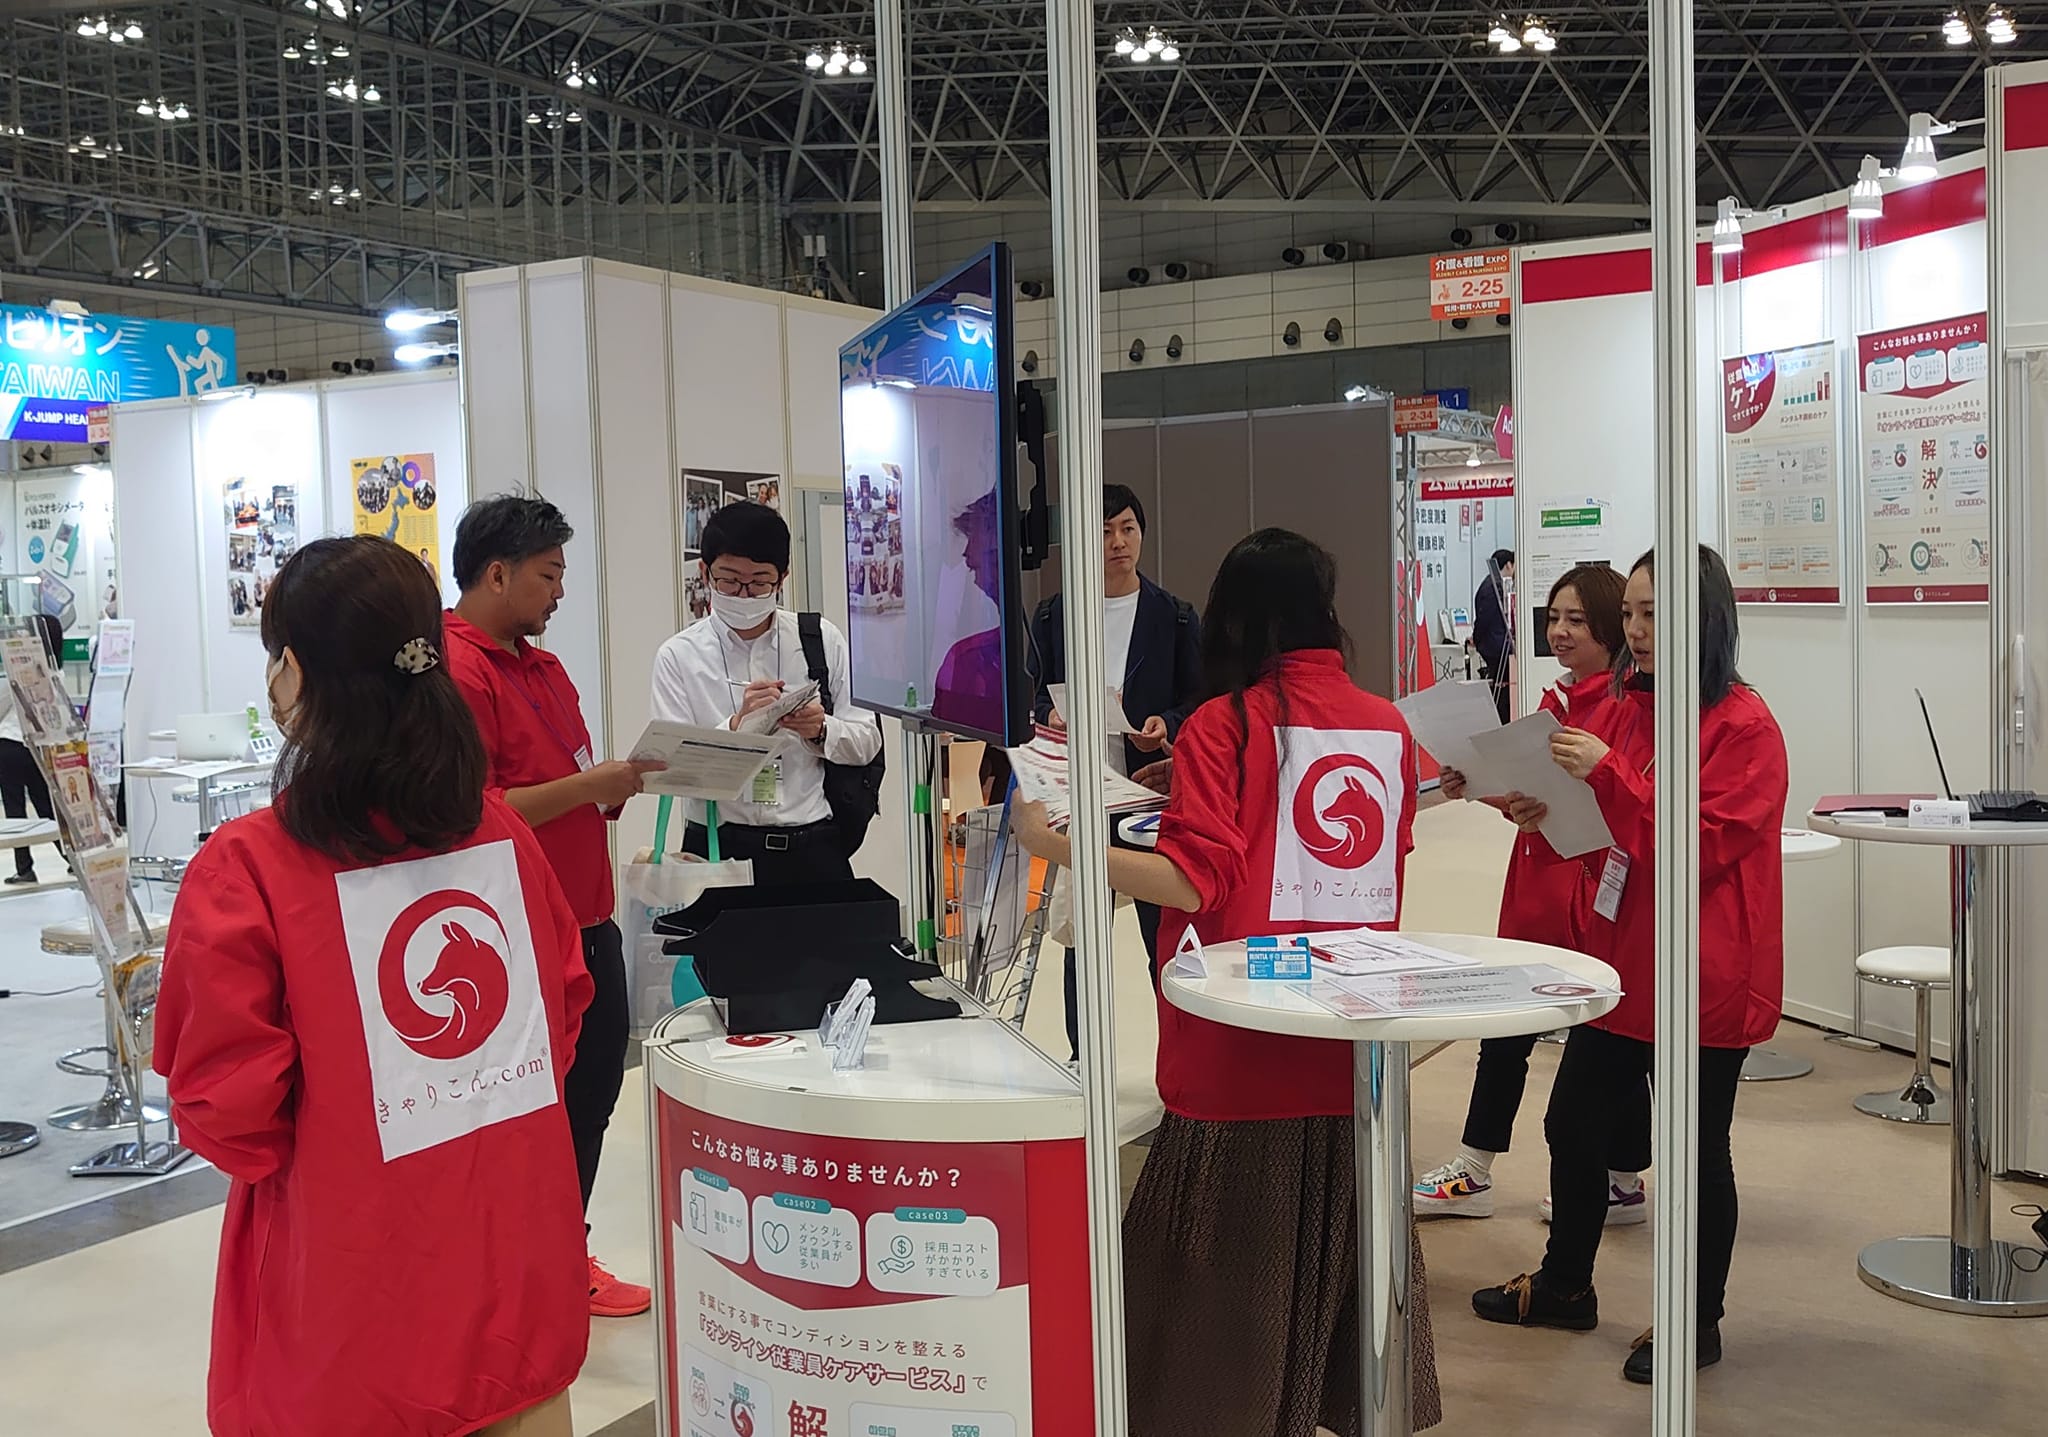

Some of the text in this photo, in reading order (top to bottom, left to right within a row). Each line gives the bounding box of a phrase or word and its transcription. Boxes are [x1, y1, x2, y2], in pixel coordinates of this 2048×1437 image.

[1486, 254, 1508, 264] EXPO
[1462, 278, 1504, 297] 2-25
[0, 362, 120, 403] AIWAN
[1730, 379, 1760, 409] ケア
[24, 409, 64, 424] K-JUMP
[1410, 410, 1433, 421] 2-34
[691, 1130, 961, 1188] こんなお悩み事ありませんか？
[783, 1197, 817, 1211] case02
[908, 1211, 949, 1221] case03
[800, 1222, 842, 1237] メンタル
[799, 1234, 854, 1251] ダウンする
[925, 1241, 989, 1254] 採用コスト
[799, 1246, 842, 1262] 従業員が
[925, 1253, 975, 1267] がかかり
[799, 1258, 820, 1270] 多い
[926, 1267, 990, 1280] すぎている
[698, 1290, 967, 1359] 言葉にする事でコンディションを整える
